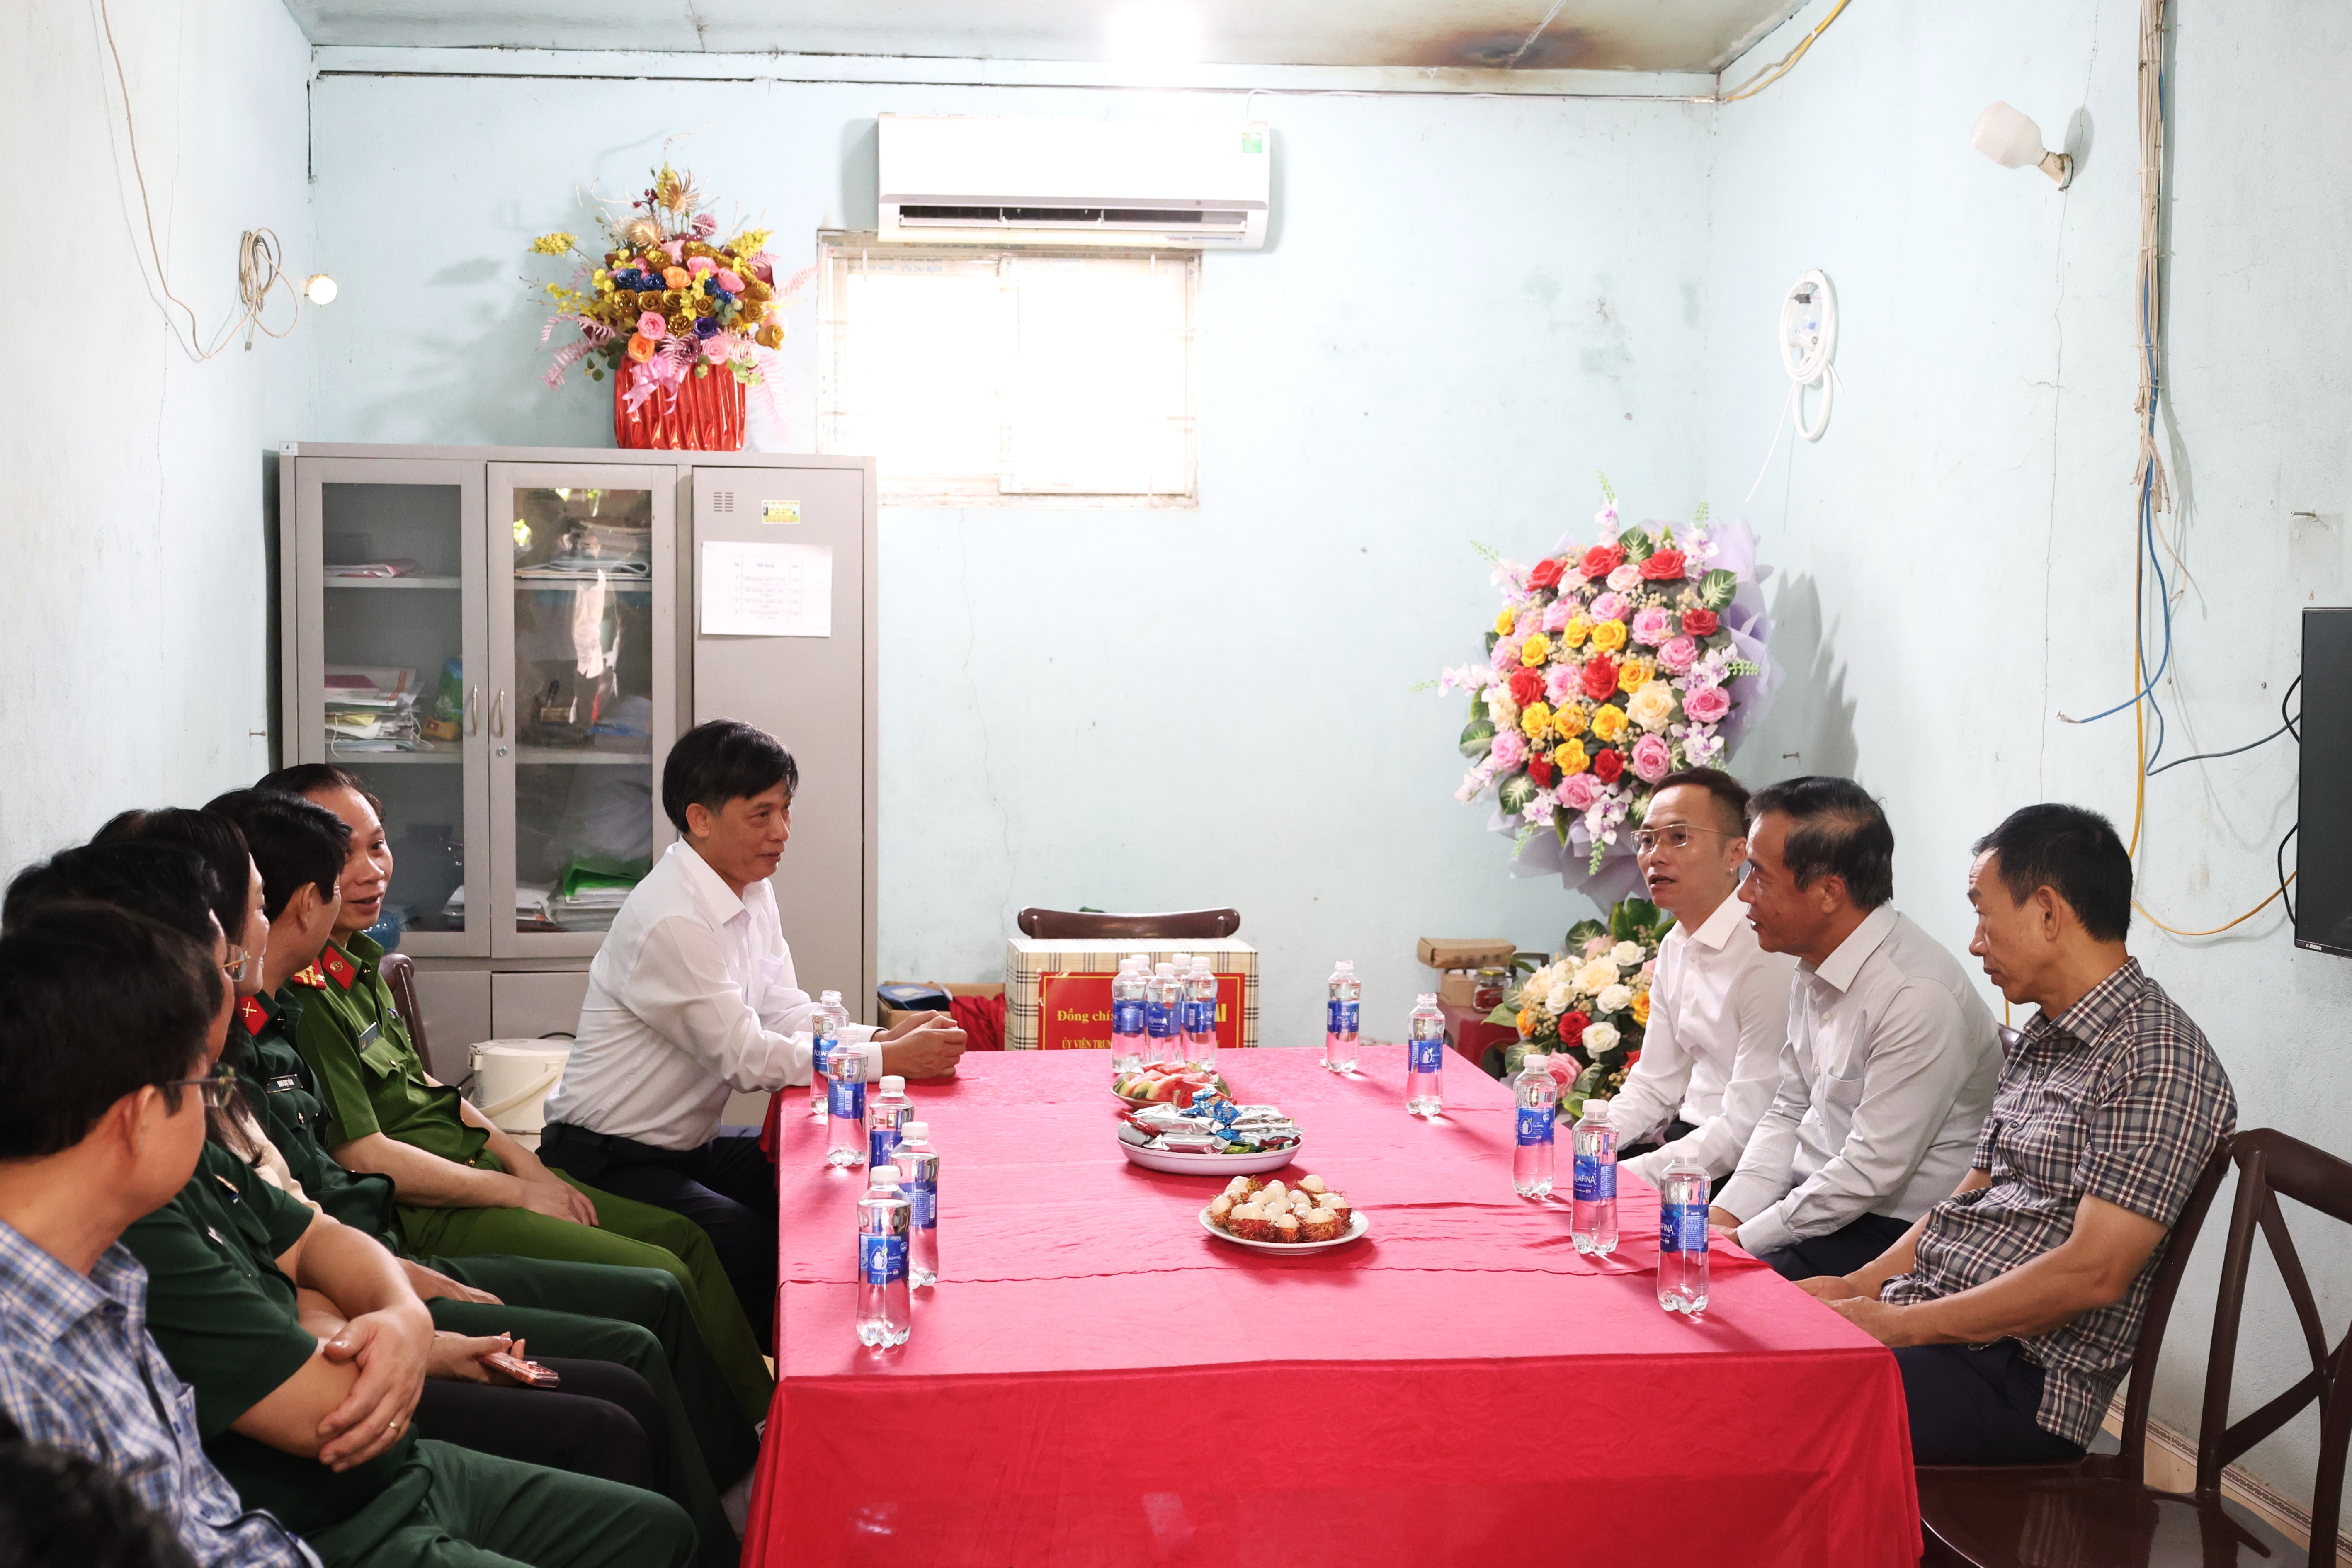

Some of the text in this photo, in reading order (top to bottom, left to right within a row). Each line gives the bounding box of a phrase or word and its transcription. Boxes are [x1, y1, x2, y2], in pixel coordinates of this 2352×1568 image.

[1057, 1008, 1089, 1024] Đồng
[1074, 1037, 1092, 1049] VIÊN
[1092, 1039, 1112, 1049] TRUN
